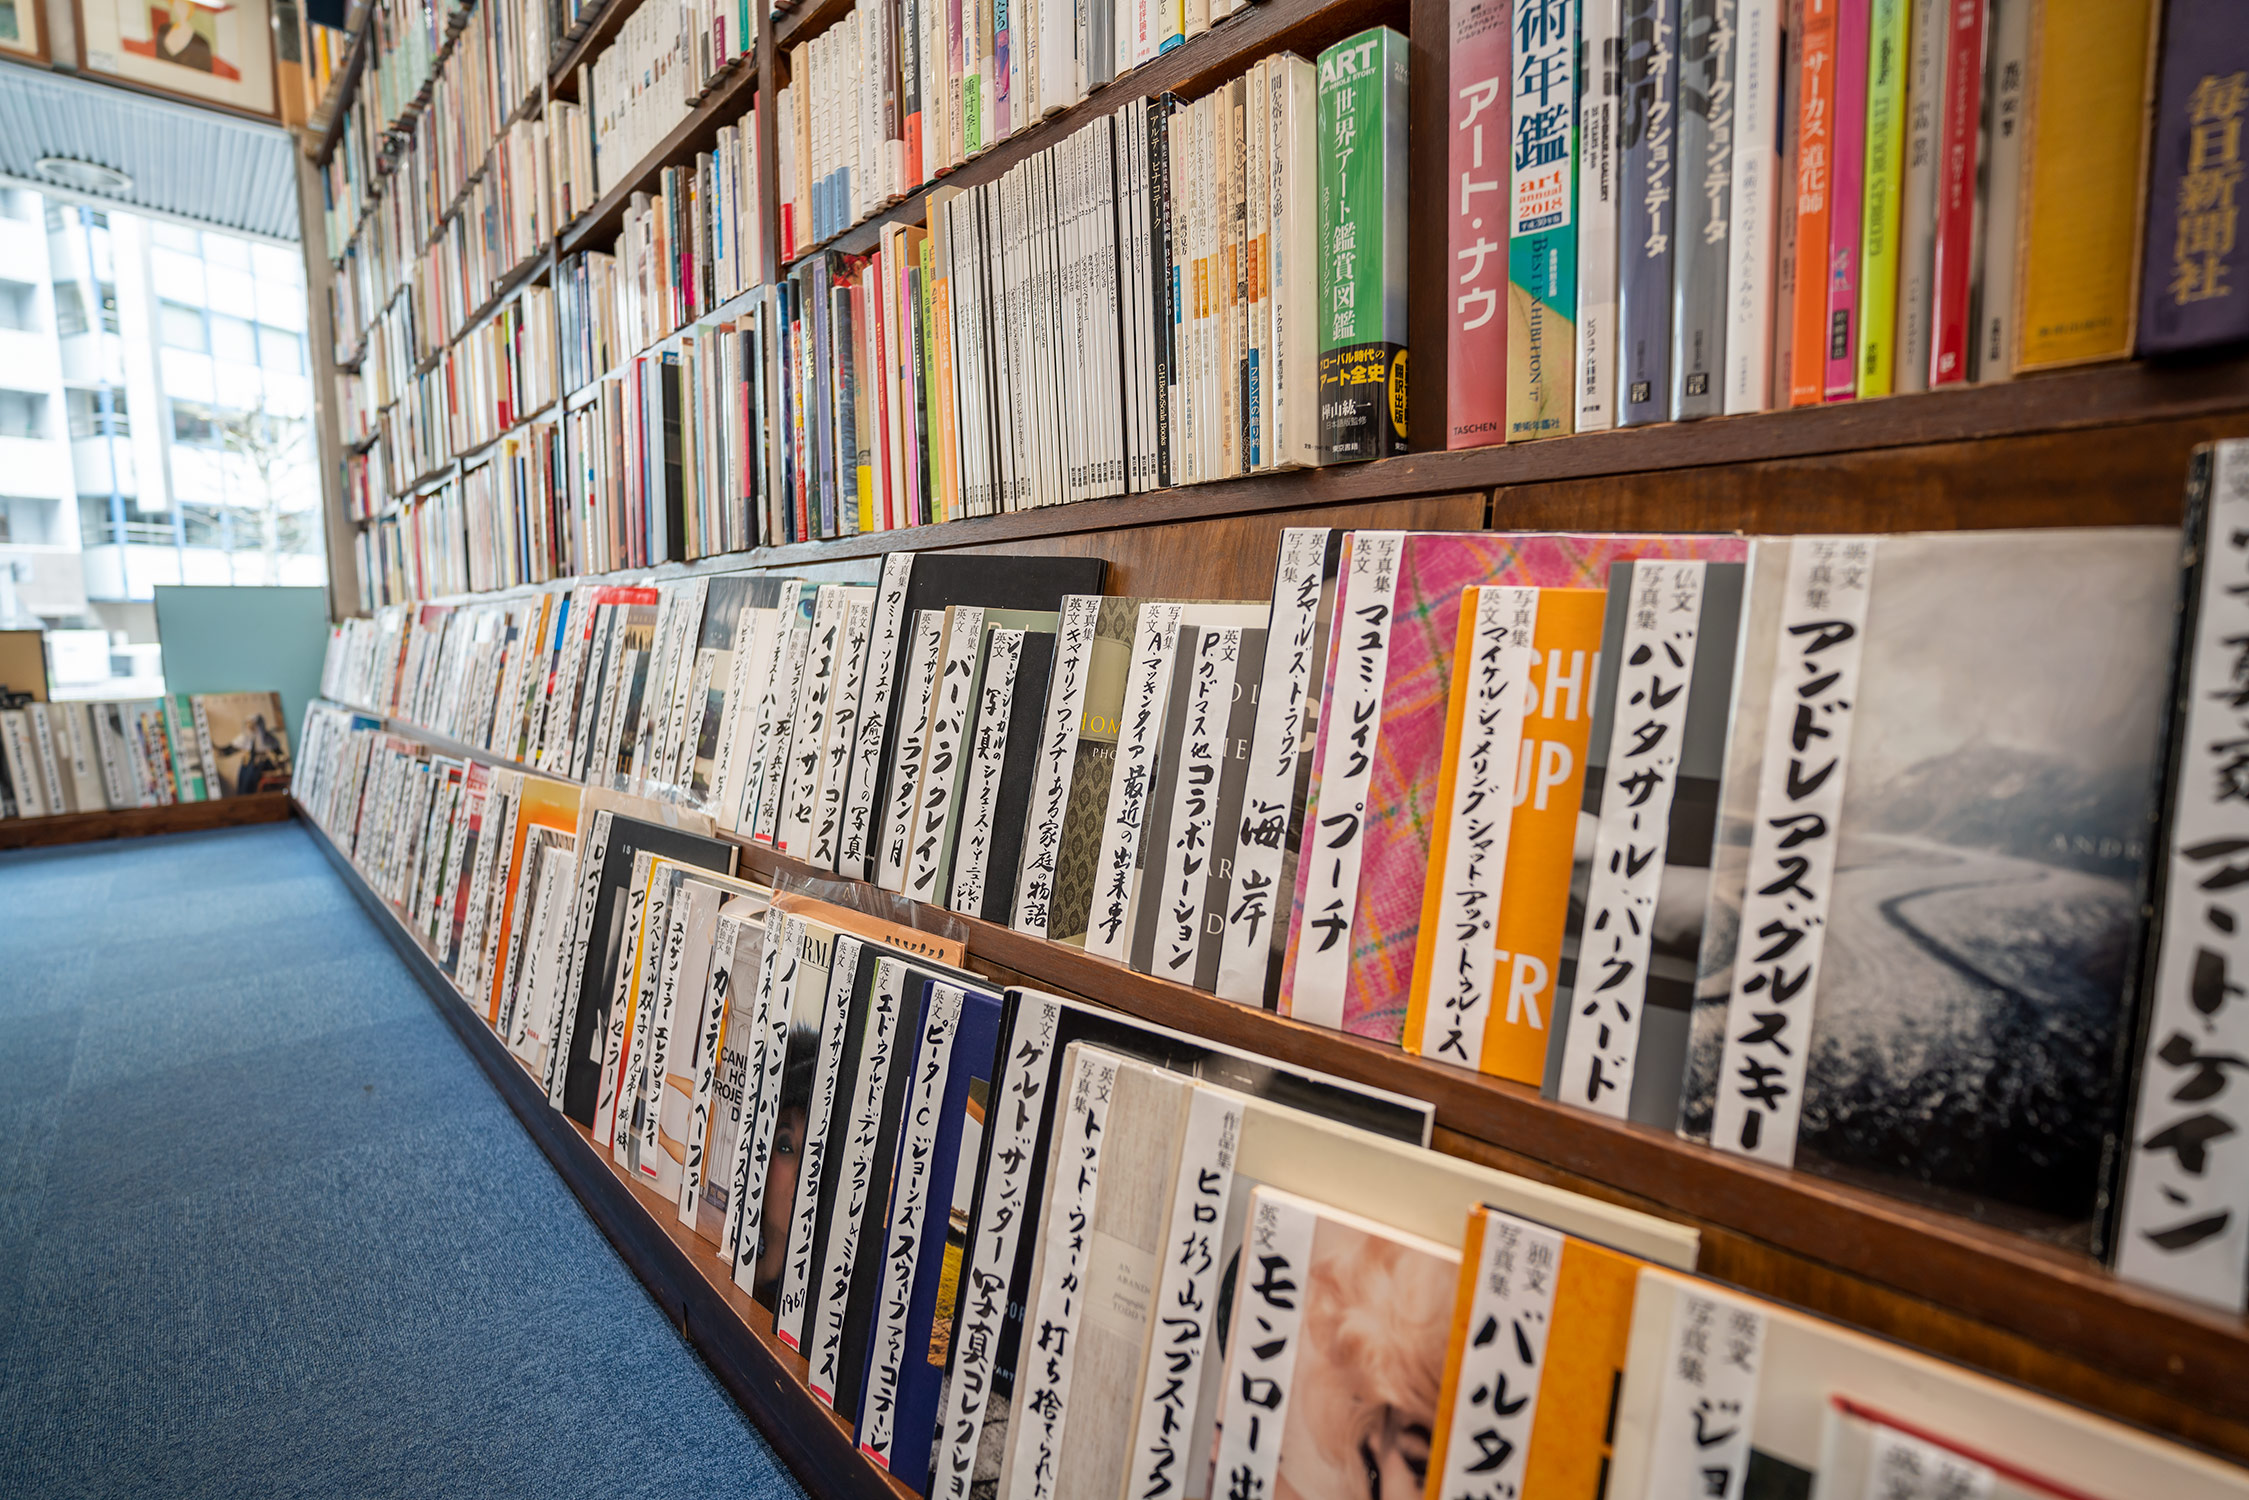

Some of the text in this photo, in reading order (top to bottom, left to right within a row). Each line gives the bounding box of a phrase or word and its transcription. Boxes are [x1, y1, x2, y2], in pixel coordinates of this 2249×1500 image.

[1320, 39, 1378, 90] ART
[1329, 77, 1352, 92] WHOLE
[1352, 67, 1377, 82] STORY
[1798, 51, 1829, 216] サーカス 道化師
[1150, 114, 1162, 229] アルテ・ピナコテーク
[1520, 170, 1563, 194] art
[2167, 70, 2249, 305] 毎日新聞社
[1457, 76, 1499, 331] アート・ナウ
[1519, 184, 1563, 204] annual
[1519, 197, 1563, 219] 2018
[1333, 87, 1357, 341] 世界アート鑑賞図鑑
[1319, 363, 1385, 392] アート全史
[1453, 422, 1497, 435] TASCHEN
[1333, 442, 1358, 453] 東京書籍
[885, 554, 898, 577] 英文
[1282, 532, 1304, 584] 写真集
[1308, 533, 1325, 568] 英文
[1353, 539, 1373, 575] 英文
[1373, 539, 1396, 594] 写真集
[897, 553, 914, 588] 写真集
[1480, 589, 1502, 626] 英文
[1636, 566, 1664, 632] 写真集
[1670, 567, 1698, 613] 仏文
[848, 604, 860, 638] 写真集
[858, 606, 870, 629] 英文
[919, 612, 932, 637] 英文
[954, 608, 968, 633] 英文
[1066, 597, 1083, 627] 英文
[1082, 599, 1099, 642] 写真集
[1145, 605, 1161, 634] 英文
[1162, 605, 1182, 651] 写真集
[1510, 590, 1534, 648] 写真集
[967, 611, 984, 650] 写真集
[992, 633, 1007, 659] 英文
[1220, 629, 1239, 663] 英文
[1230, 799, 1286, 948] 海岸
[1311, 802, 1364, 953] プーチ
[784, 917, 796, 944] 英文
[836, 941, 848, 968] 英文
[847, 944, 860, 986] 写真集
[877, 960, 892, 991] 英文
[930, 989, 946, 1020] 英文
[1039, 1002, 1058, 1040] 英文
[1072, 1059, 1095, 1115] 写真集
[1097, 1065, 1115, 1104] 英文
[1252, 1202, 1281, 1251] 英文
[781, 1288, 807, 1317] 1967
